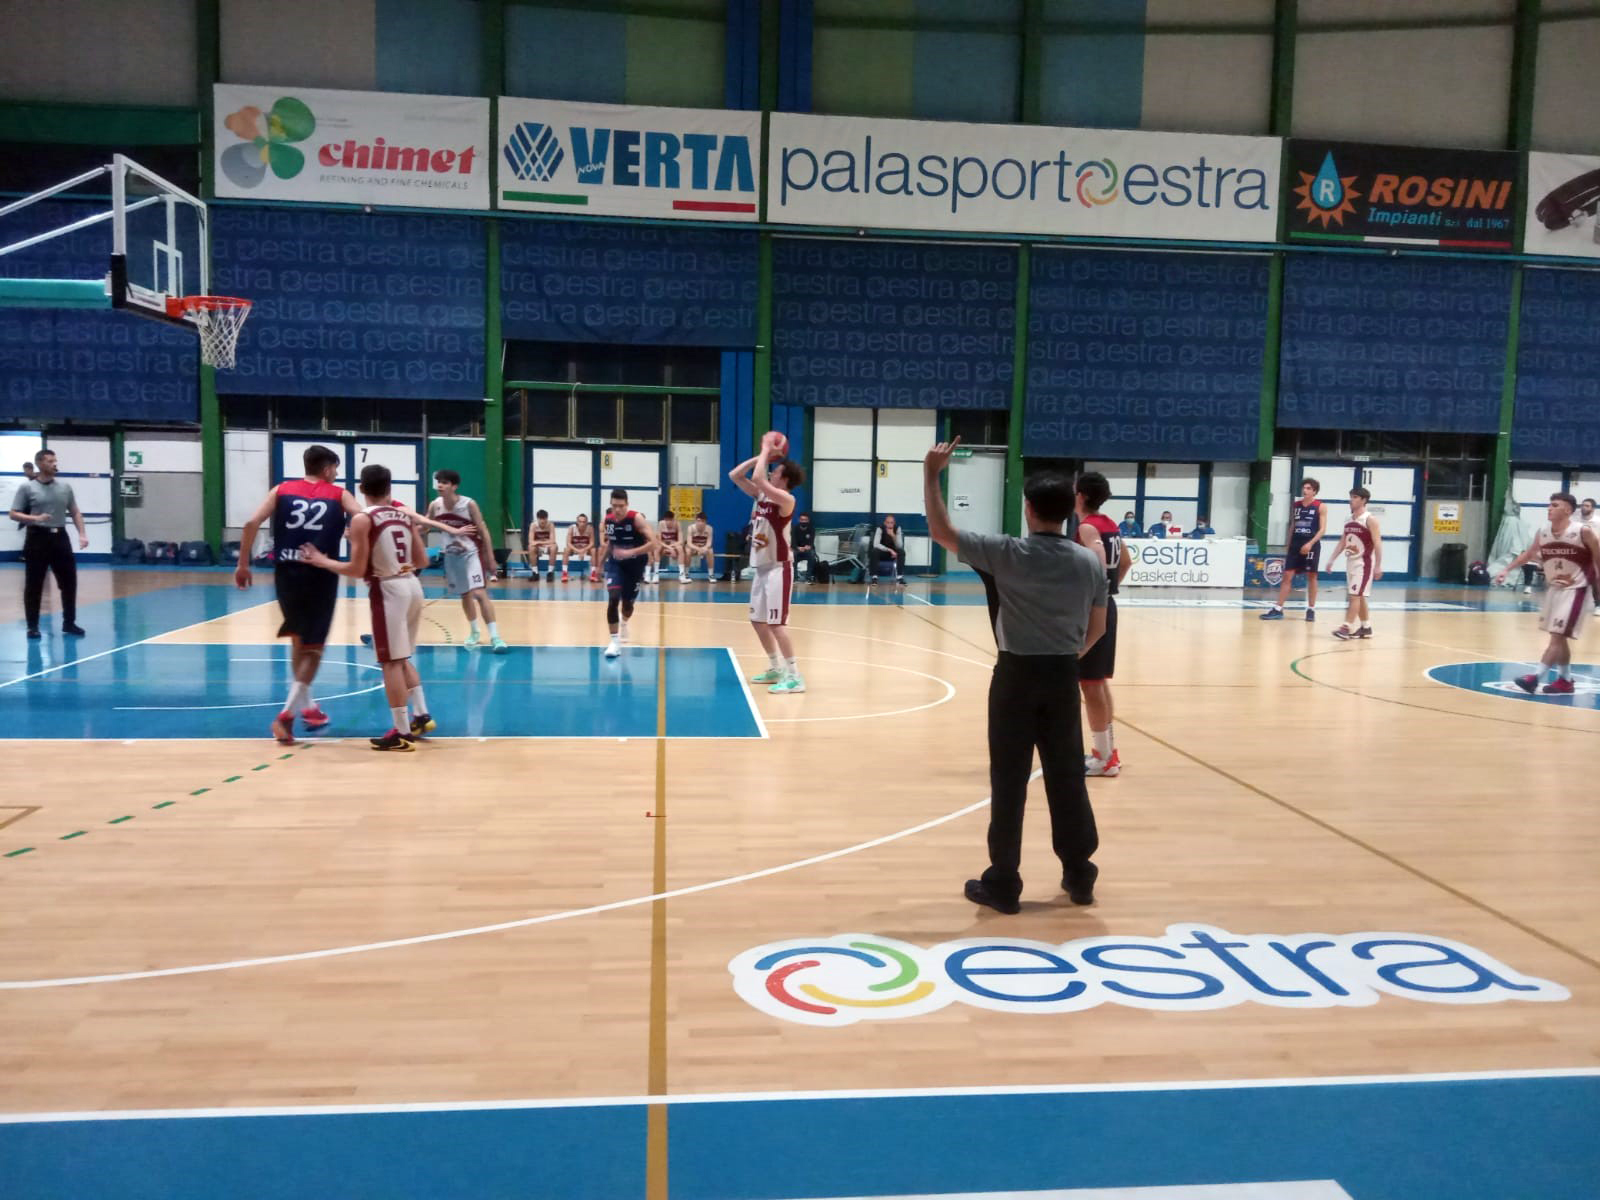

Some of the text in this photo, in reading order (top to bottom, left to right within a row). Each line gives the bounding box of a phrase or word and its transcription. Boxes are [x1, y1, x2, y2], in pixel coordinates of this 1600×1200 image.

[318, 137, 476, 174] chimet
[568, 126, 755, 192] VERTA
[577, 162, 607, 175] NOVA
[781, 135, 1270, 213] palasport estra
[319, 175, 469, 190] REFINING AND FINE CHEMICALS
[1319, 178, 1335, 203] R
[1368, 174, 1513, 210] ROSINI
[1367, 207, 1443, 226] Impianti
[1466, 217, 1483, 229] dal
[361, 447, 369, 464] 7
[879, 463, 886, 477] 9
[1363, 470, 1373, 485] 11
[285, 499, 328, 531] 32
[391, 530, 408, 564] 5
[1142, 542, 1210, 566] estra
[1131, 568, 1209, 584] basket club
[769, 608, 779, 620] 11
[944, 929, 1540, 1002] estra
